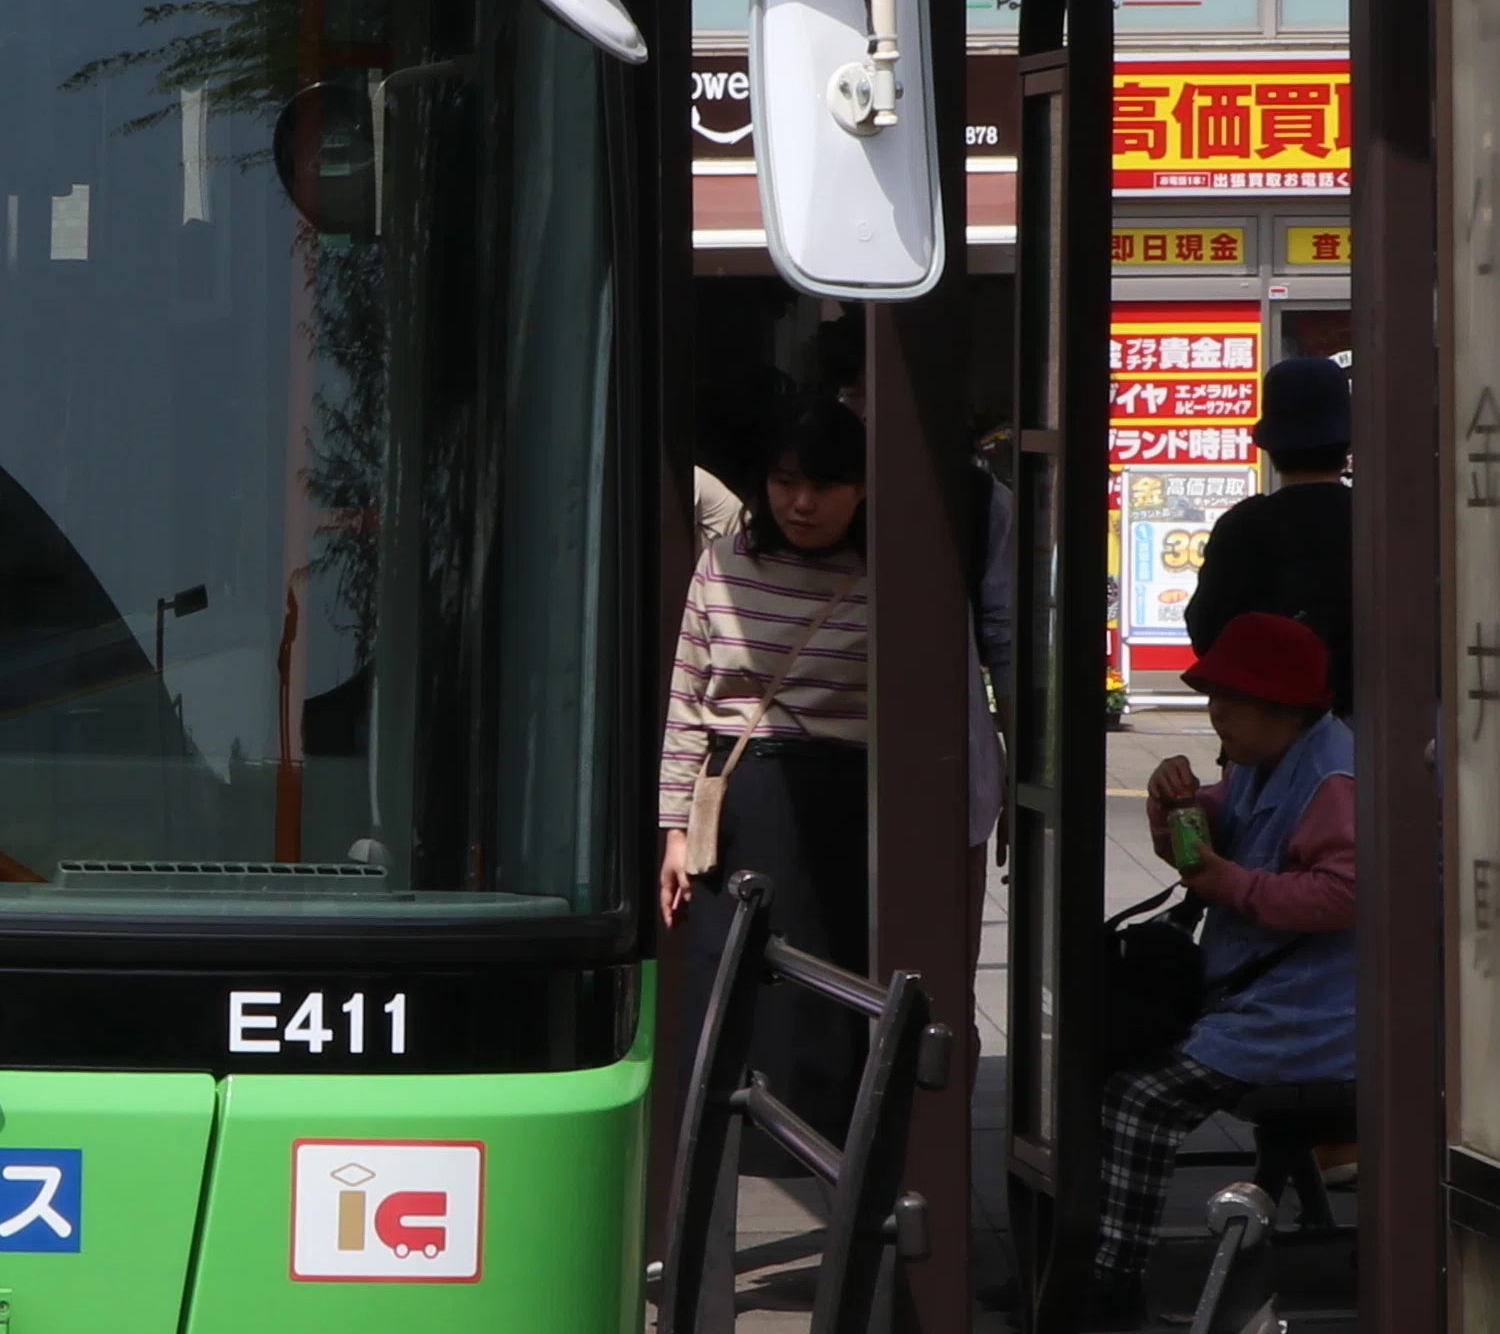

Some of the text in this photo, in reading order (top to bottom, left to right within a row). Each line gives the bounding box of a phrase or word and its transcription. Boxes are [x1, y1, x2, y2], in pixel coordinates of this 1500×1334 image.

[1159, 337, 1253, 369] 貴金属
[1174, 384, 1253, 399] エメラルド
[1132, 477, 1245, 507] 金 高価買取
[228, 991, 408, 1053] E411
